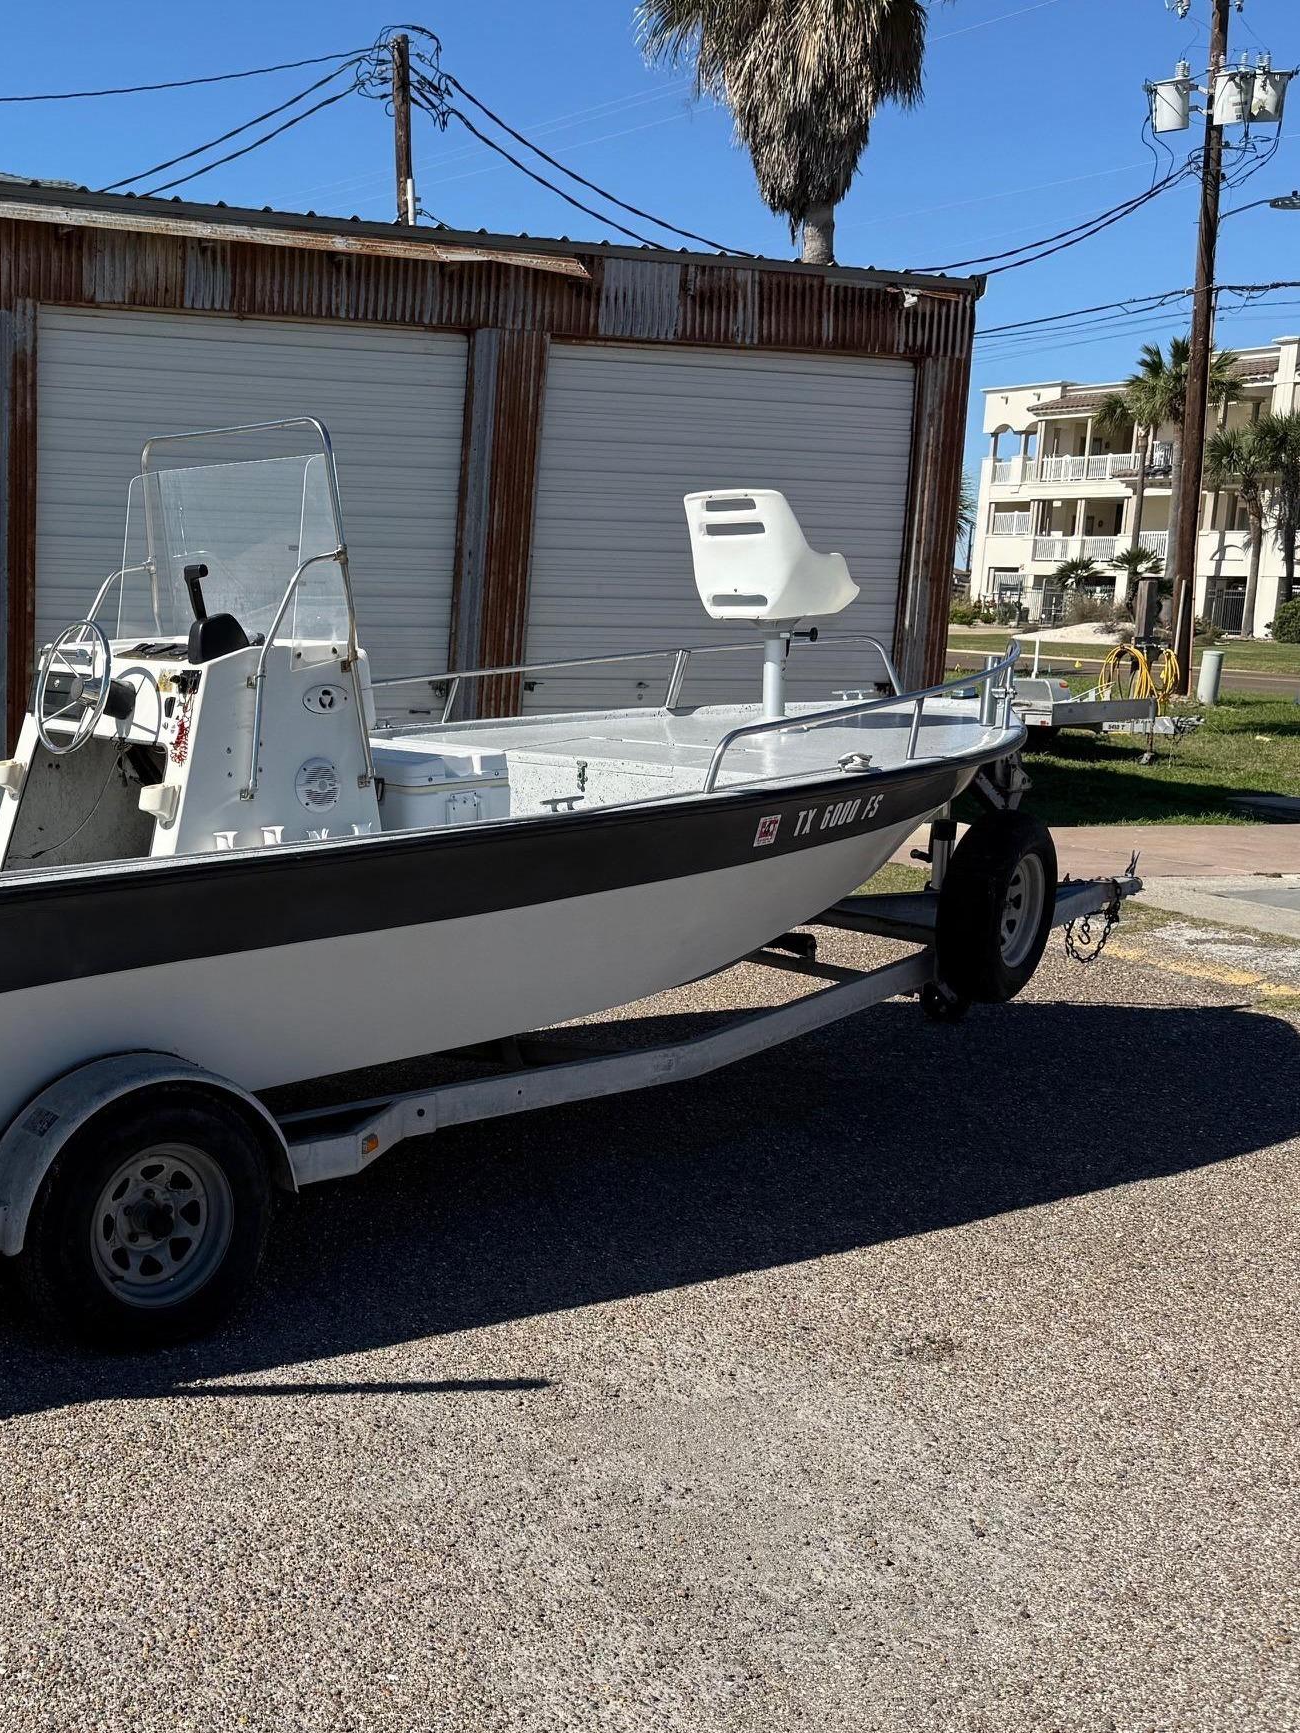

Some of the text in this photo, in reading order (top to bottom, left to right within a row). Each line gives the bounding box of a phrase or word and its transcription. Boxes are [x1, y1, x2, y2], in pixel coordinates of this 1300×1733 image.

[793, 808, 818, 837] TX
[820, 798, 862, 830] 6000
[861, 793, 885, 820] FS
